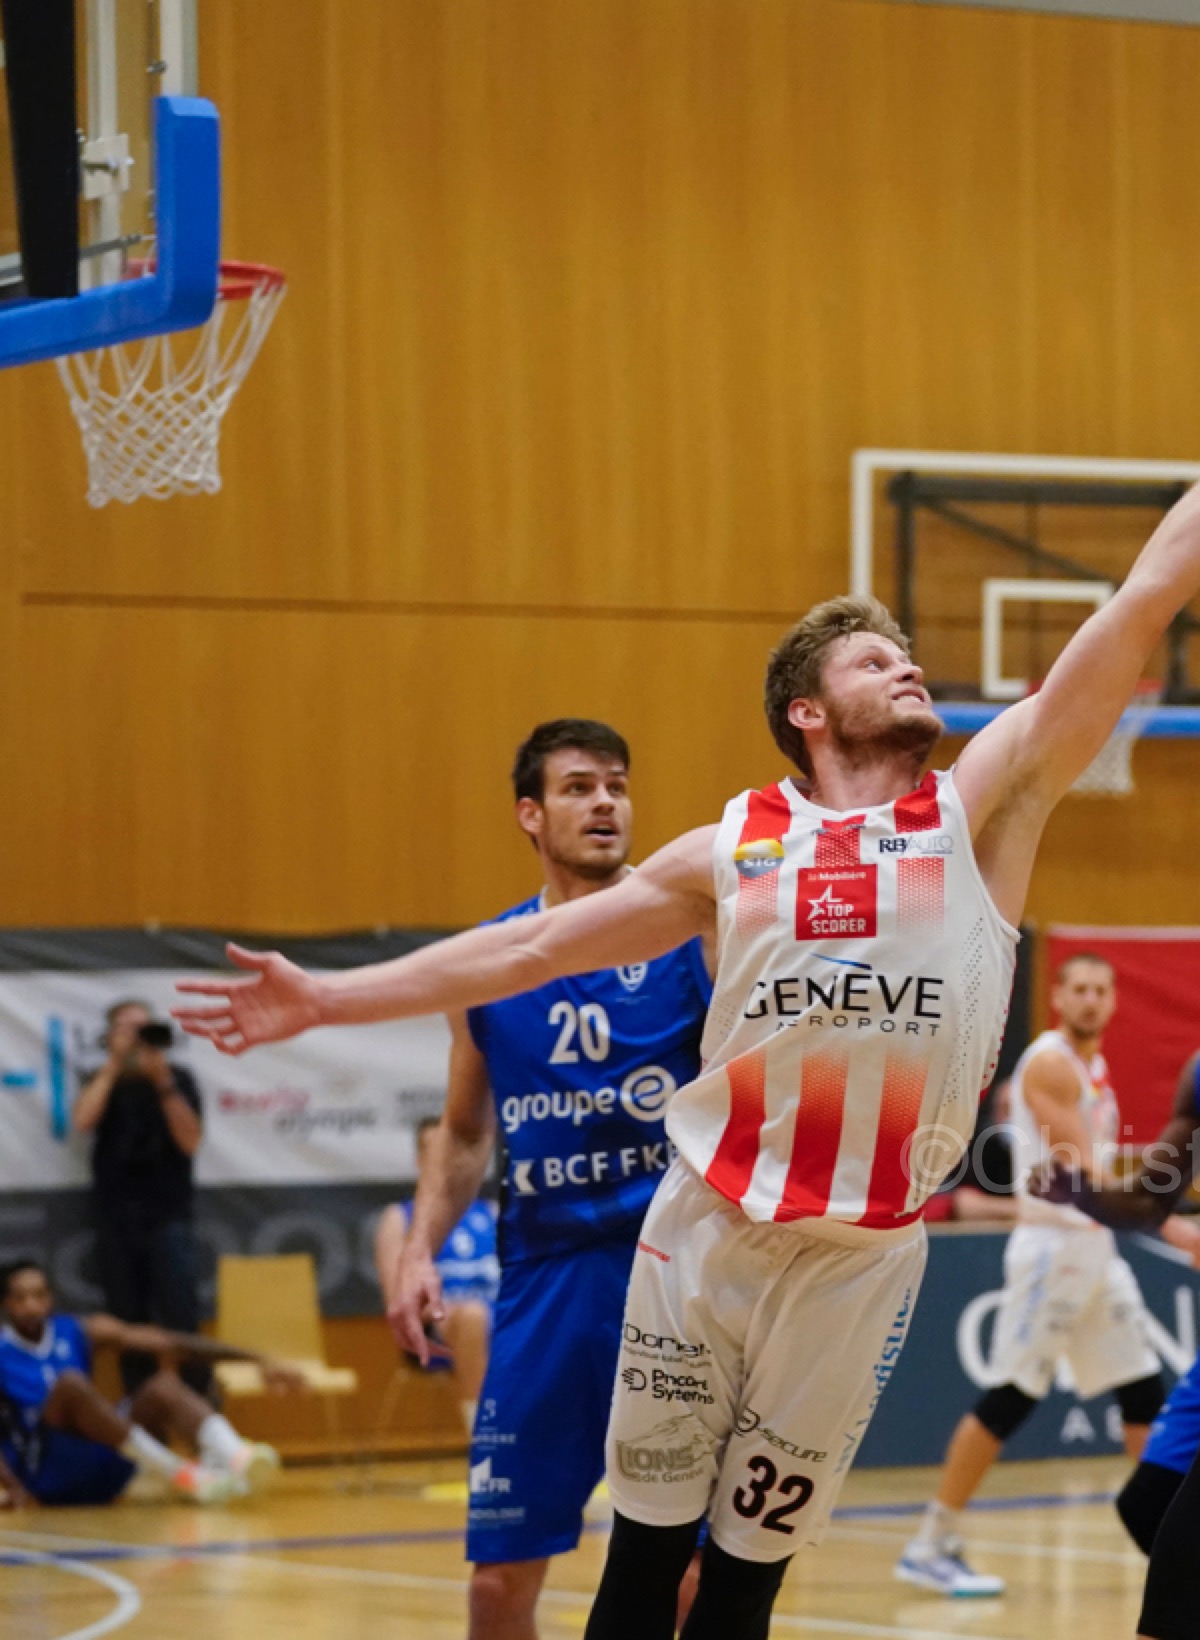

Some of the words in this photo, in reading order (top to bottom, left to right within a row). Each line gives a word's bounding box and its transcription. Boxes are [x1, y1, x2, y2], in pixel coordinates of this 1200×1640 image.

[811, 918, 867, 934] SCORER
[827, 903, 855, 917] TOP
[547, 1000, 612, 1065] 20
[501, 1086, 618, 1134] groupe
[732, 1453, 815, 1535] 32
